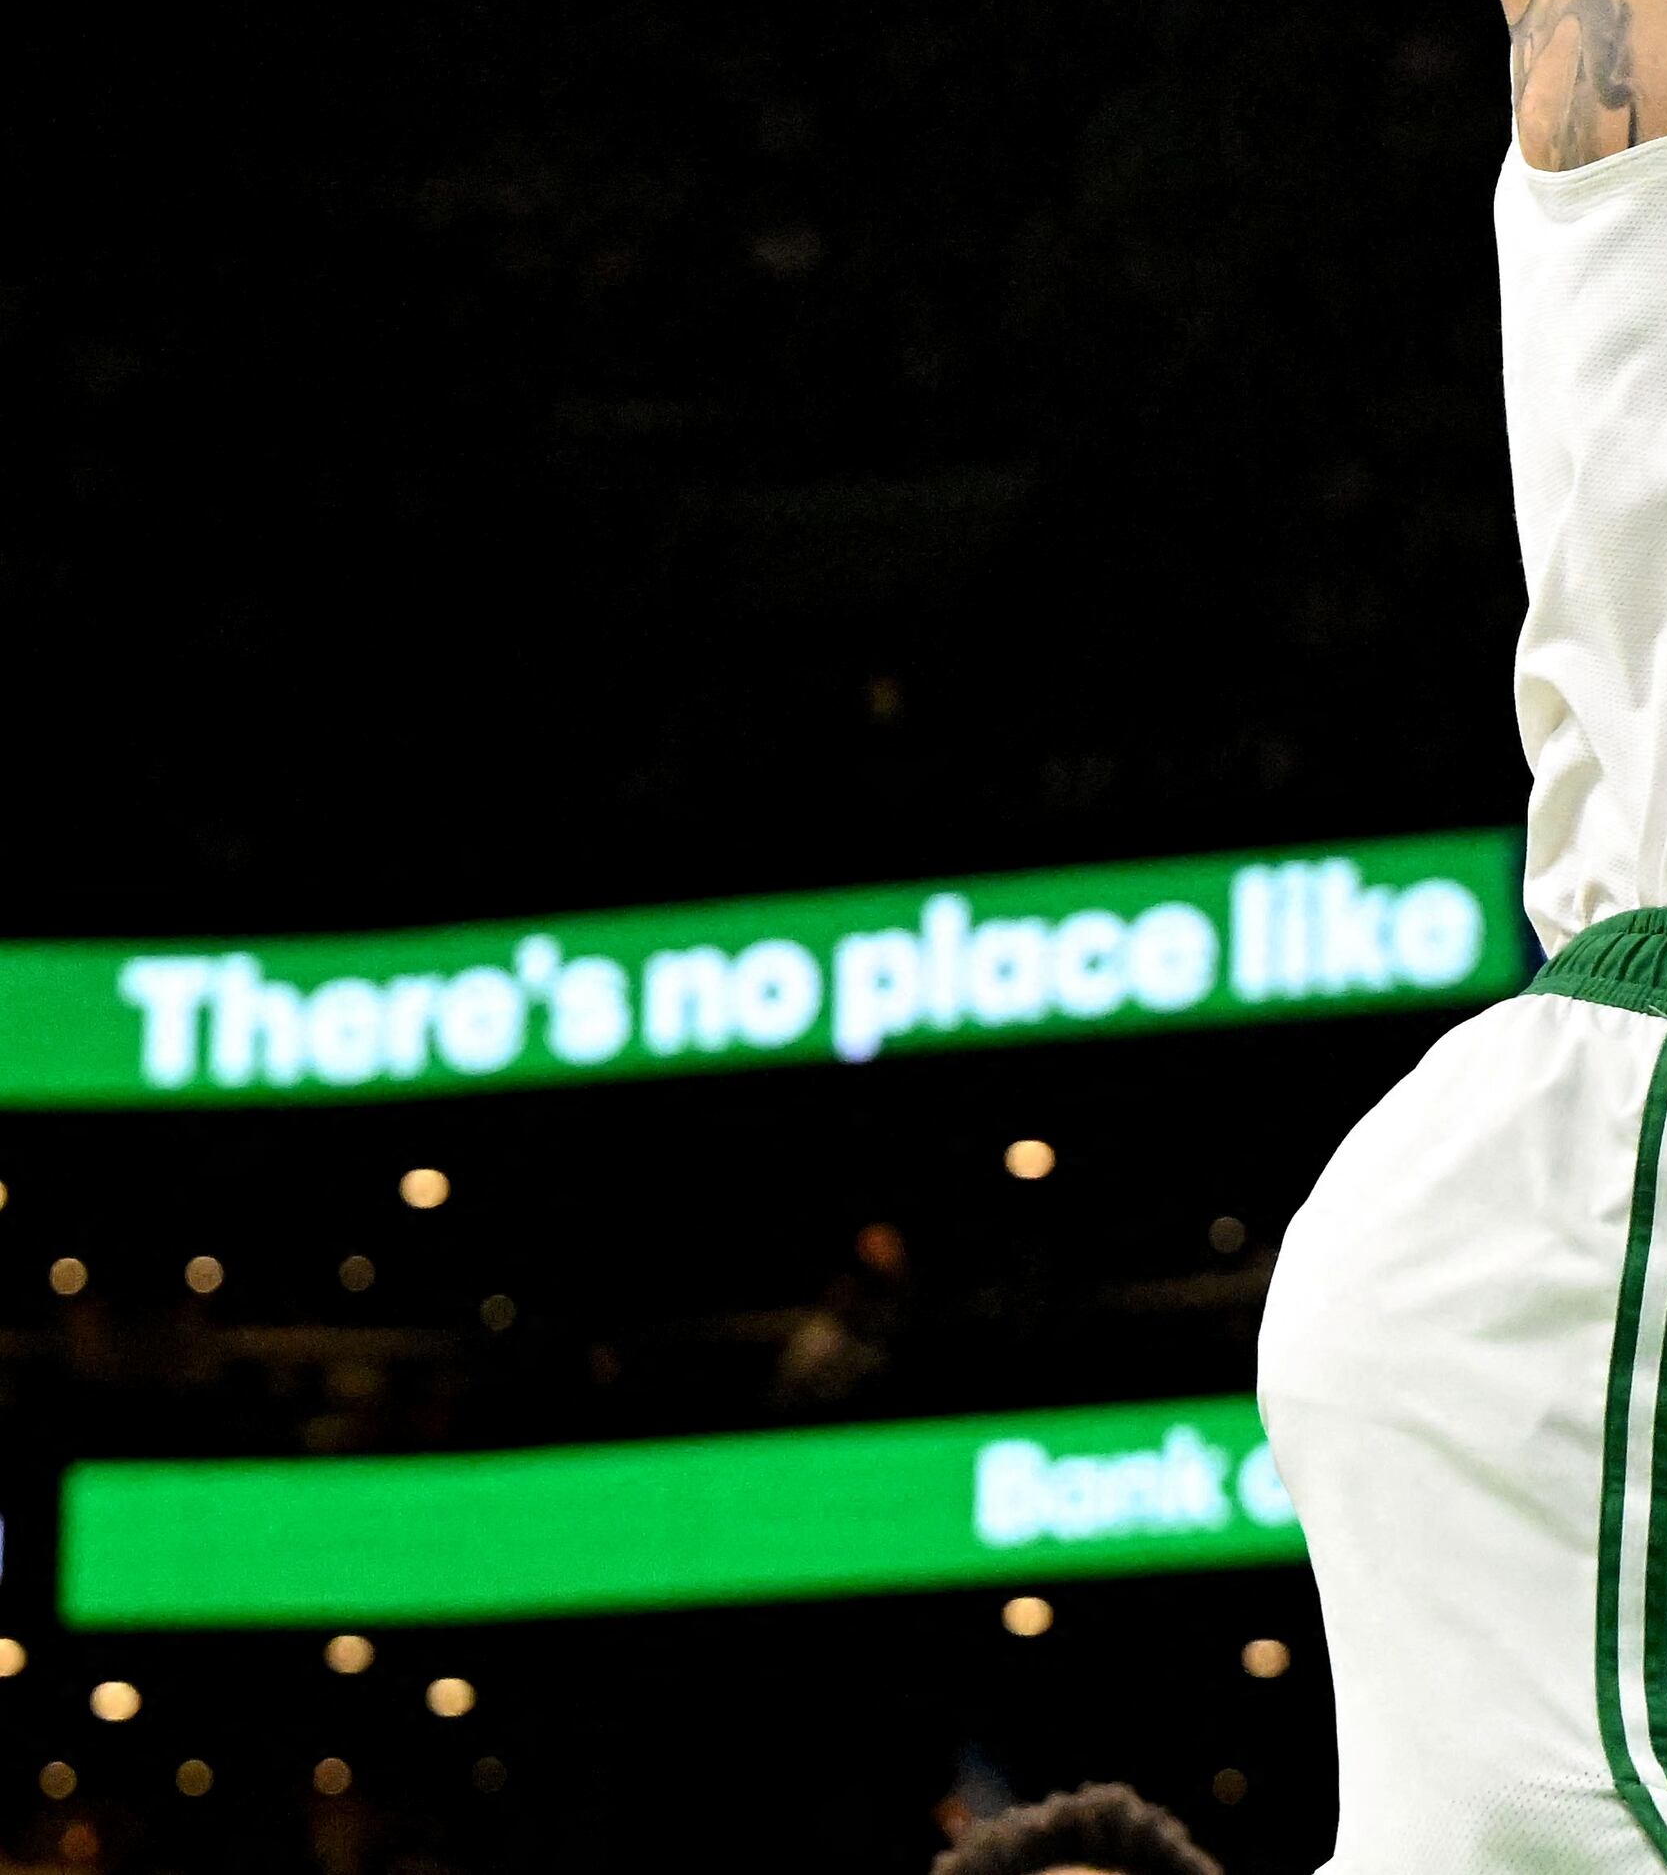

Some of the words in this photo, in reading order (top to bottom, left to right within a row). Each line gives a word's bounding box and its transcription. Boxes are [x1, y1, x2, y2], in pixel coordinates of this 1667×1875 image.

[120, 935, 629, 1089] There's
[644, 939, 821, 1055] no
[833, 893, 1219, 1063] place
[1230, 858, 1483, 1001] like
[973, 1426, 1230, 1546] Bank
